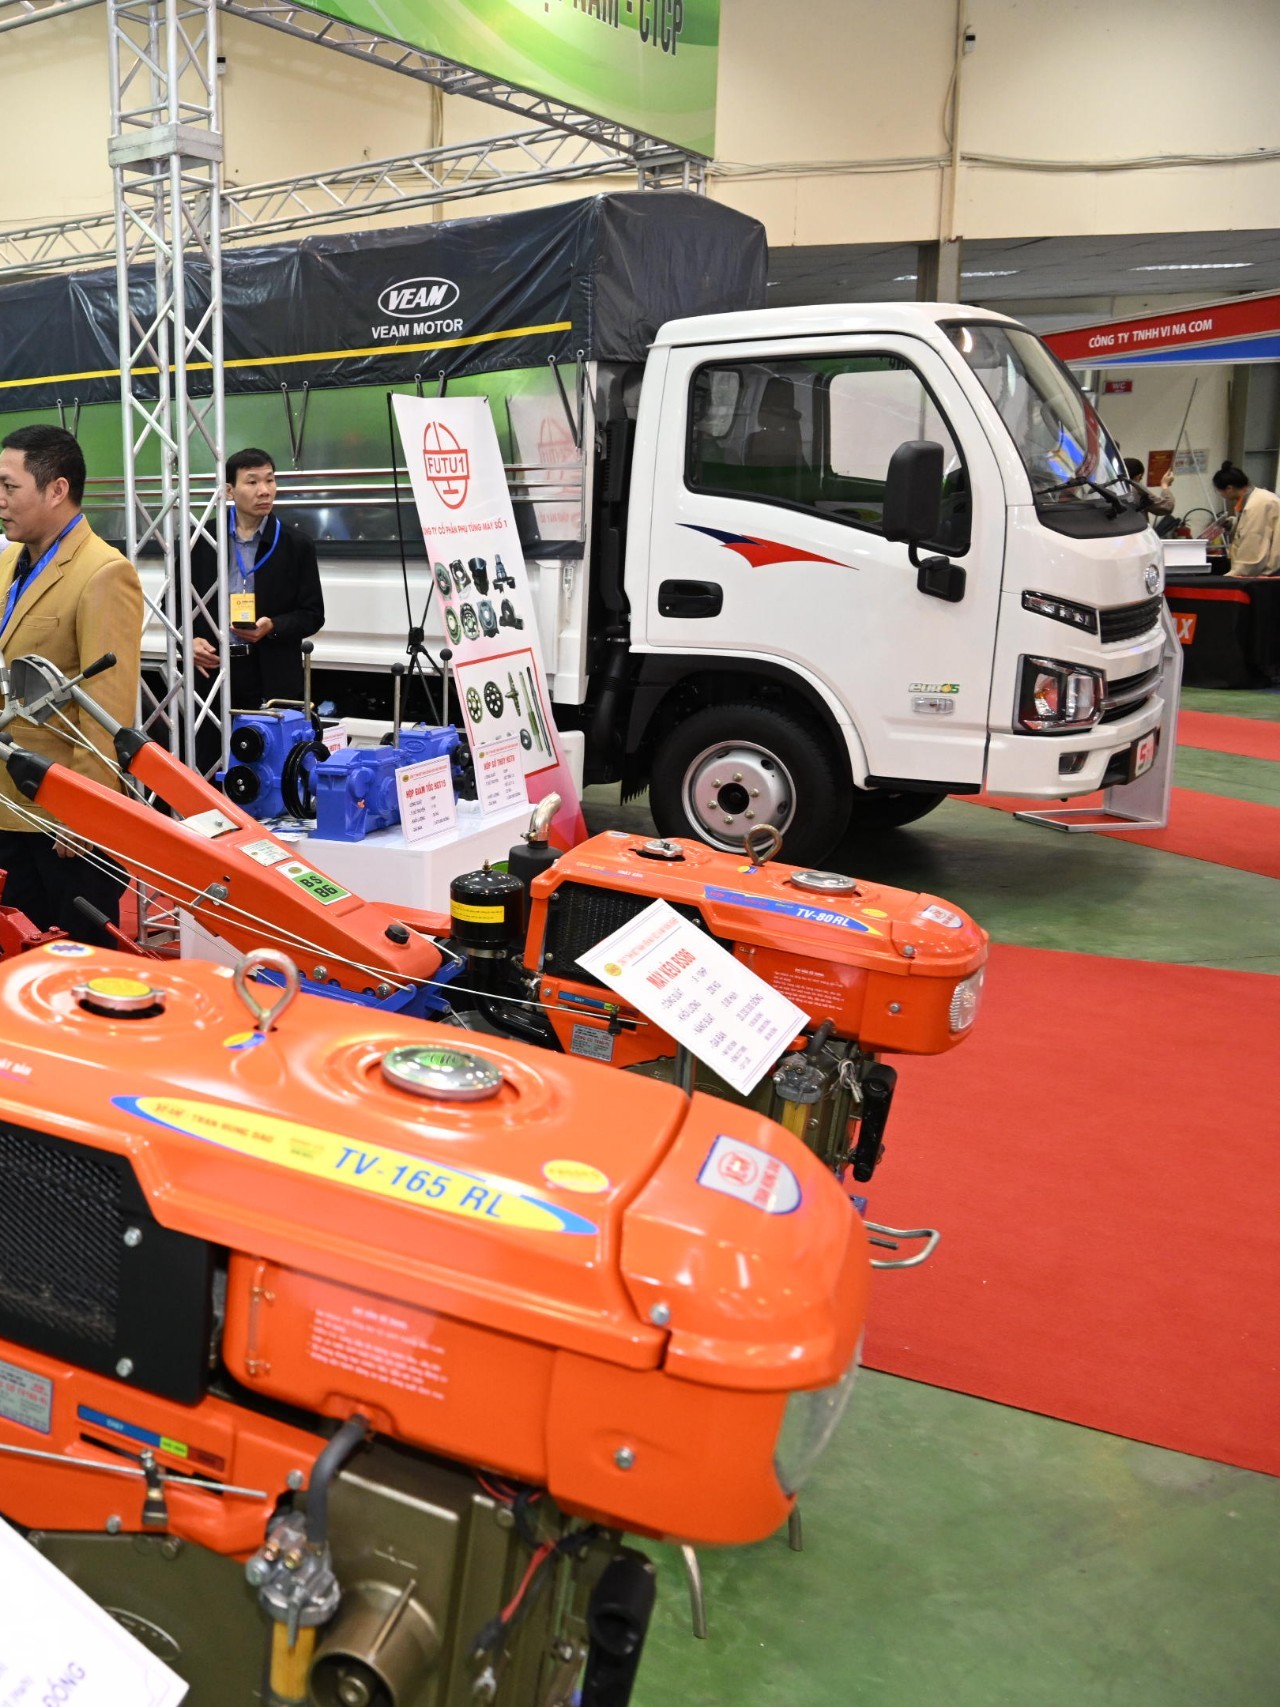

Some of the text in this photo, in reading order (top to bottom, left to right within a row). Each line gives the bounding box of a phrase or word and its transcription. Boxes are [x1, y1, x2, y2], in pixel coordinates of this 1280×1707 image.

[388, 280, 448, 310] VEAM
[371, 318, 463, 339] VEAM MOTOR
[1088, 334, 1114, 349] CÔNG
[1117, 332, 1130, 345] TY
[1132, 327, 1159, 342] TNHH
[1188, 319, 1212, 333] COM
[428, 455, 465, 475] FUTU1
[299, 875, 323, 888] BS
[334, 1146, 451, 1199] TV-165
[460, 1185, 503, 1219] RL
